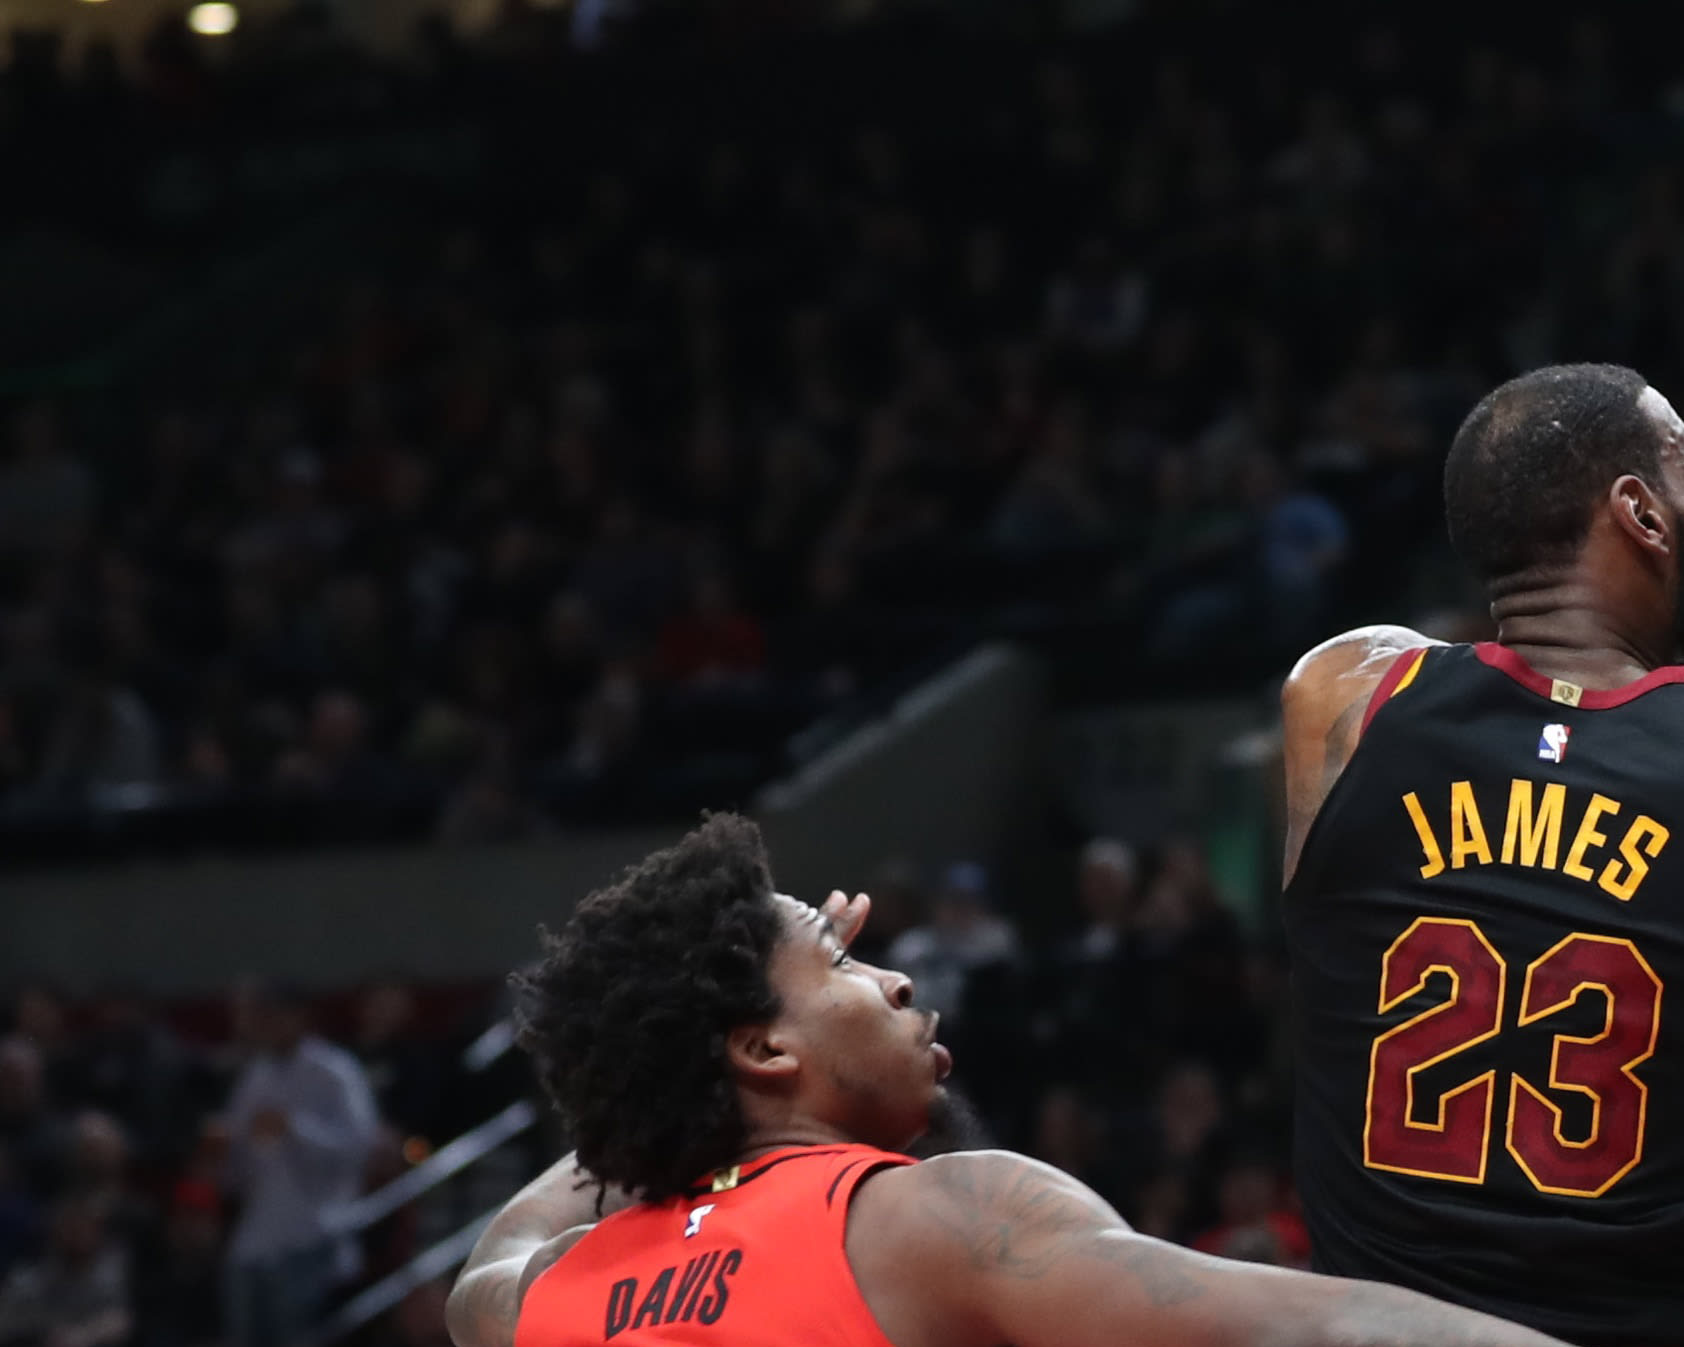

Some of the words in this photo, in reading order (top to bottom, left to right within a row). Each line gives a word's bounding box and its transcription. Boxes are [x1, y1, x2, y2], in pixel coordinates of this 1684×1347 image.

[1402, 779, 1670, 901] JAMES
[1363, 916, 1664, 1198] 23
[604, 1248, 744, 1341] DAVIS
